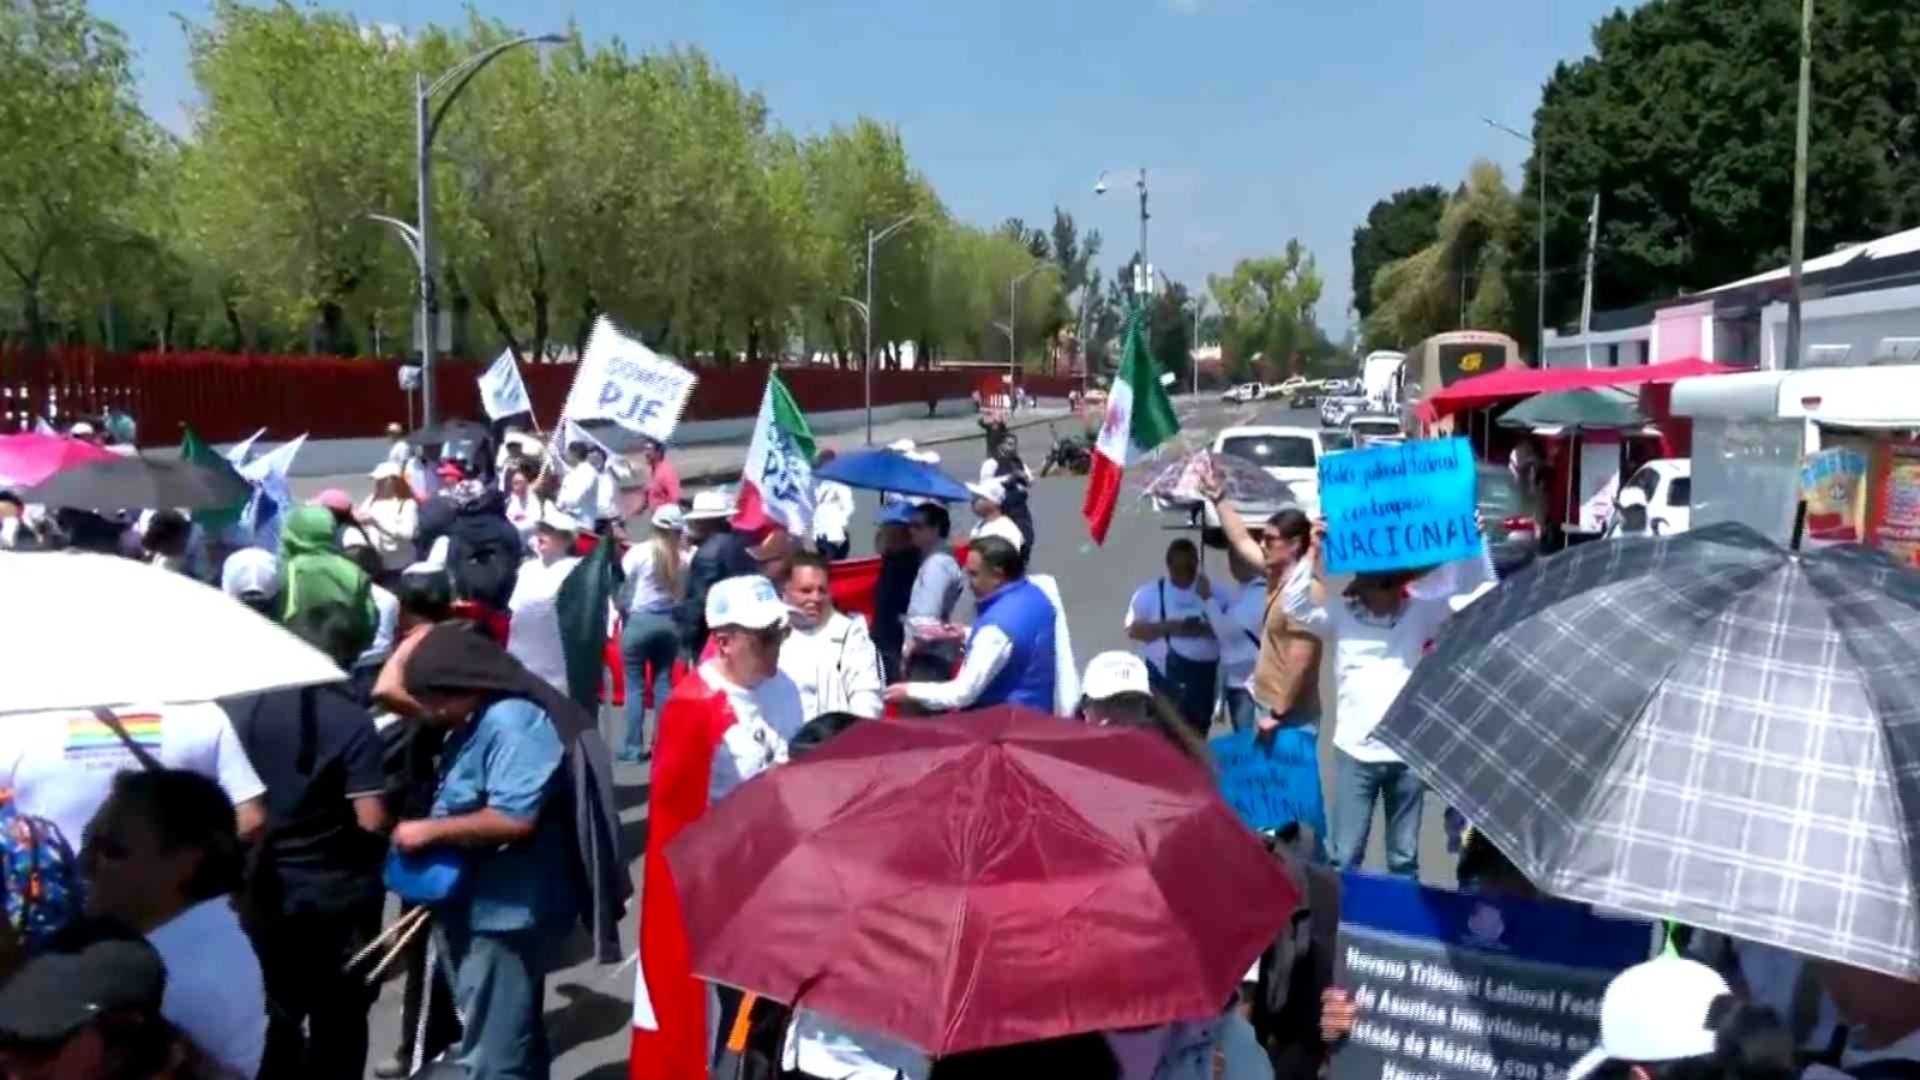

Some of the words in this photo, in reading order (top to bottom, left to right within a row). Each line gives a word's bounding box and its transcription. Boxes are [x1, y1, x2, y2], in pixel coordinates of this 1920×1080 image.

[598, 381, 664, 424] PJF
[1324, 514, 1476, 564] NACIONAL
[1345, 945, 1406, 980] Noveno
[1408, 959, 1480, 997] Tribunal
[1484, 976, 1556, 1011] Laboral
[1354, 983, 1376, 1009] de
[1378, 989, 1447, 1025] Asuntos
[1402, 1030, 1426, 1058] de
